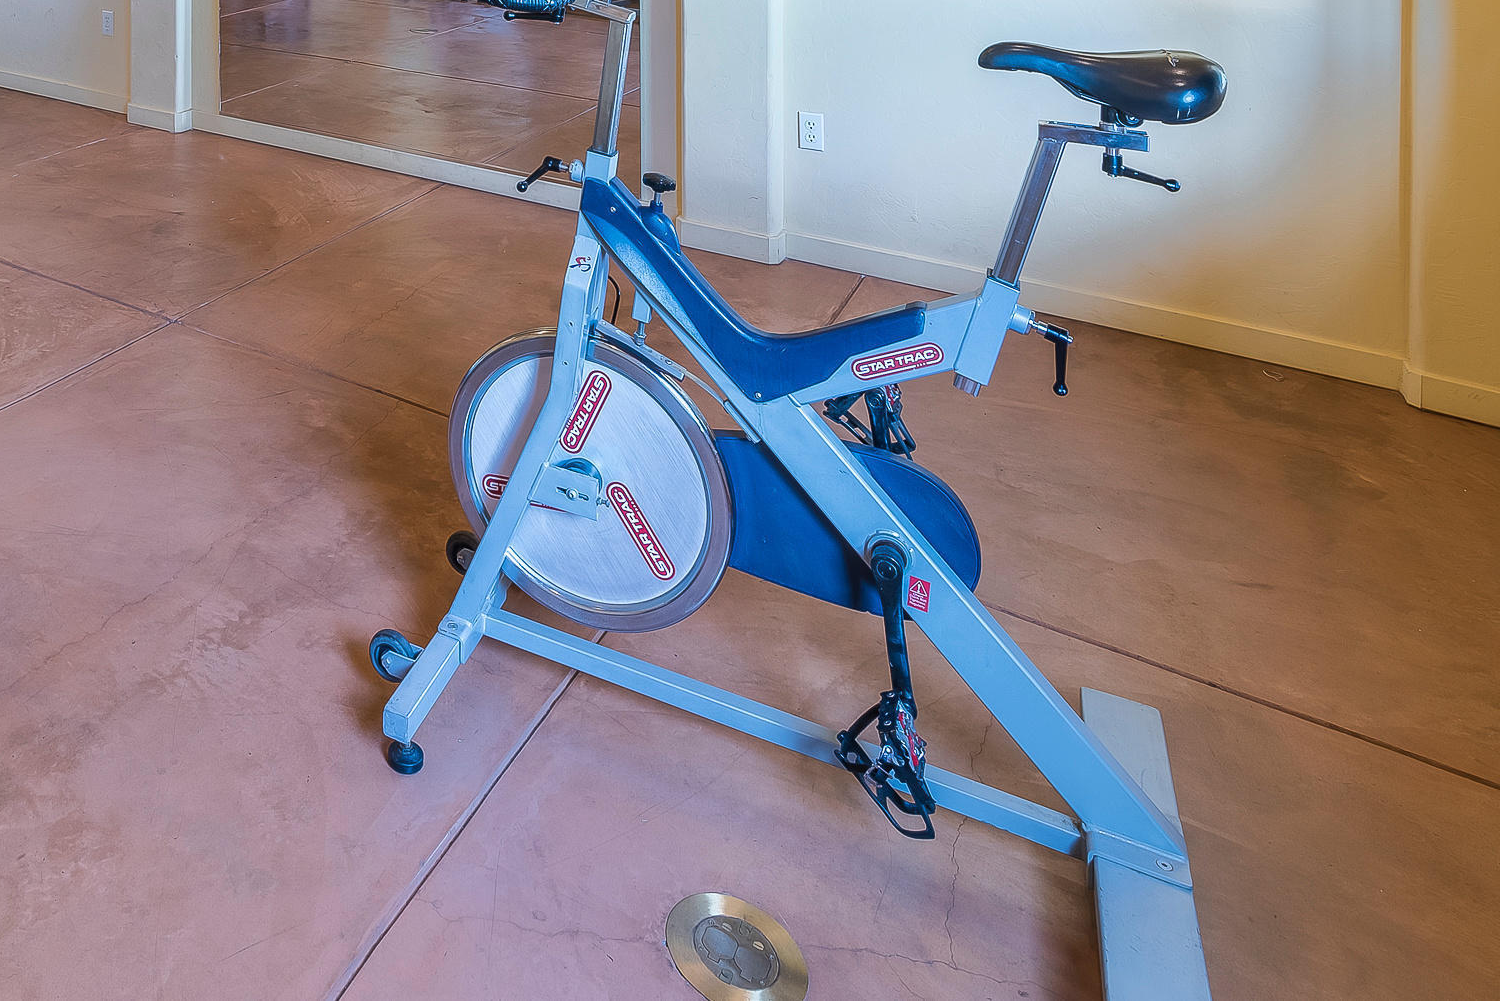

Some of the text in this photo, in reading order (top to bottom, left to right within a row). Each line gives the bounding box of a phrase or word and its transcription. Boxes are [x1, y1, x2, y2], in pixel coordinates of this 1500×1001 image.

[859, 349, 935, 375] STAR TRAC
[566, 375, 605, 446] STAR TRAC
[614, 491, 671, 573] STAR TRAC
